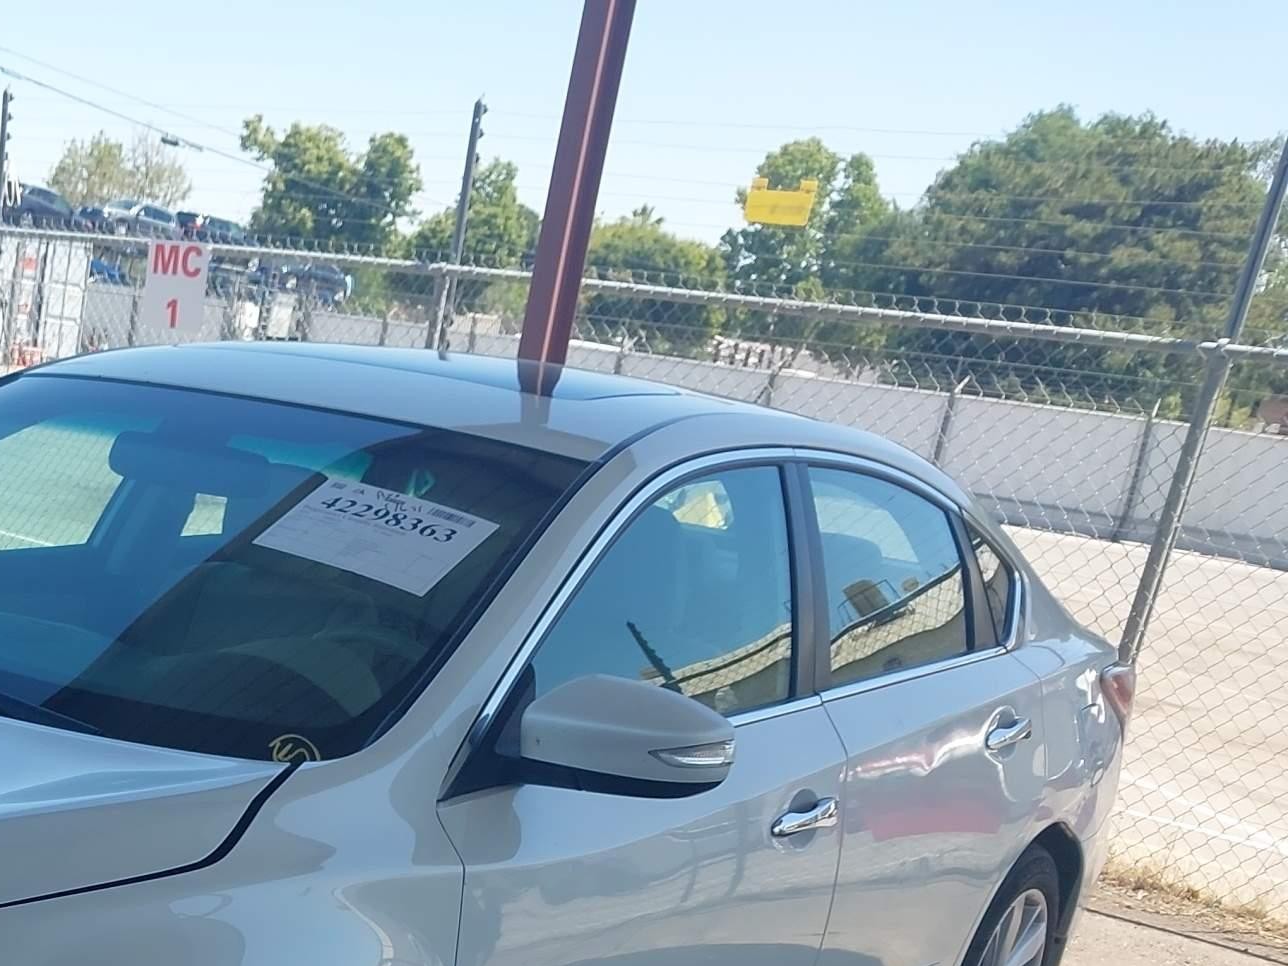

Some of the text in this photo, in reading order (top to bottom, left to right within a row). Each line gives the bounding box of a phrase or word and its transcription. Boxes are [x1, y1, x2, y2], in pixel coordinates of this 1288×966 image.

[152, 243, 203, 278] MC
[166, 298, 179, 329] 1
[321, 496, 458, 543] 42298363
